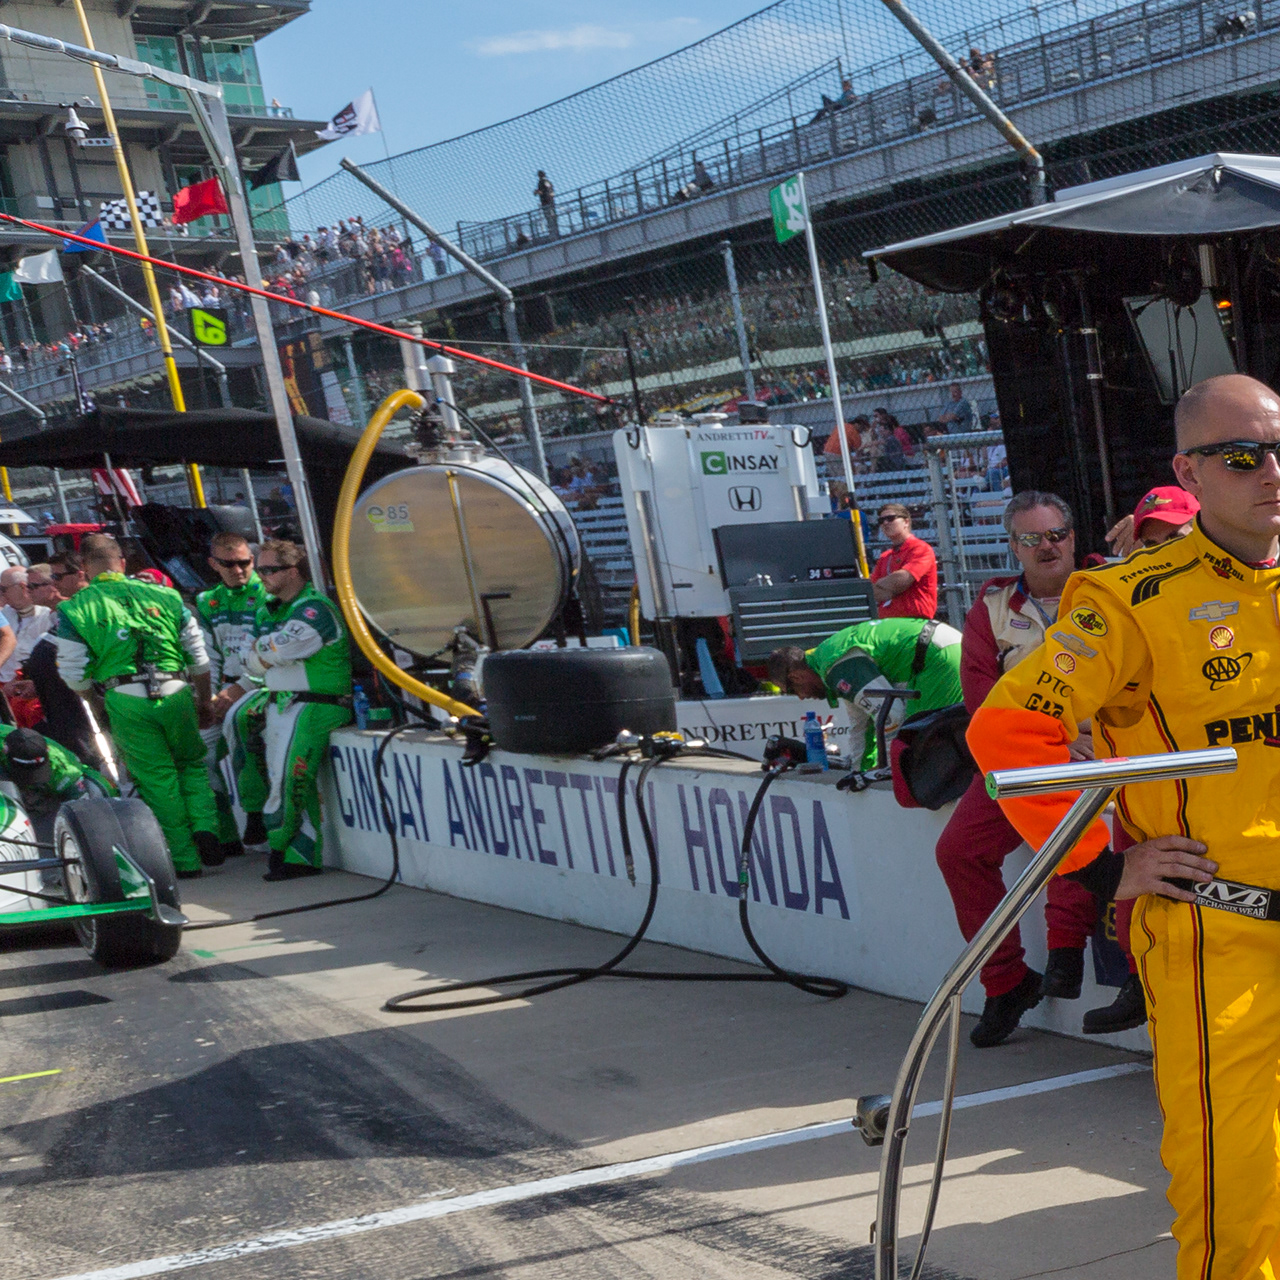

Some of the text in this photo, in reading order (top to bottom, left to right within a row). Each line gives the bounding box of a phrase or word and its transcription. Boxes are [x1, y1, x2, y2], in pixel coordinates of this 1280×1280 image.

[704, 454, 778, 472] CINSAY
[1119, 561, 1174, 583] Firestone
[1204, 551, 1246, 582] PENNZOIL
[1208, 661, 1240, 676] AAA
[1036, 670, 1074, 698] PTC
[331, 746, 430, 842] CINSAY
[677, 784, 851, 920] HONDA
[1240, 904, 1267, 918] WEAR
